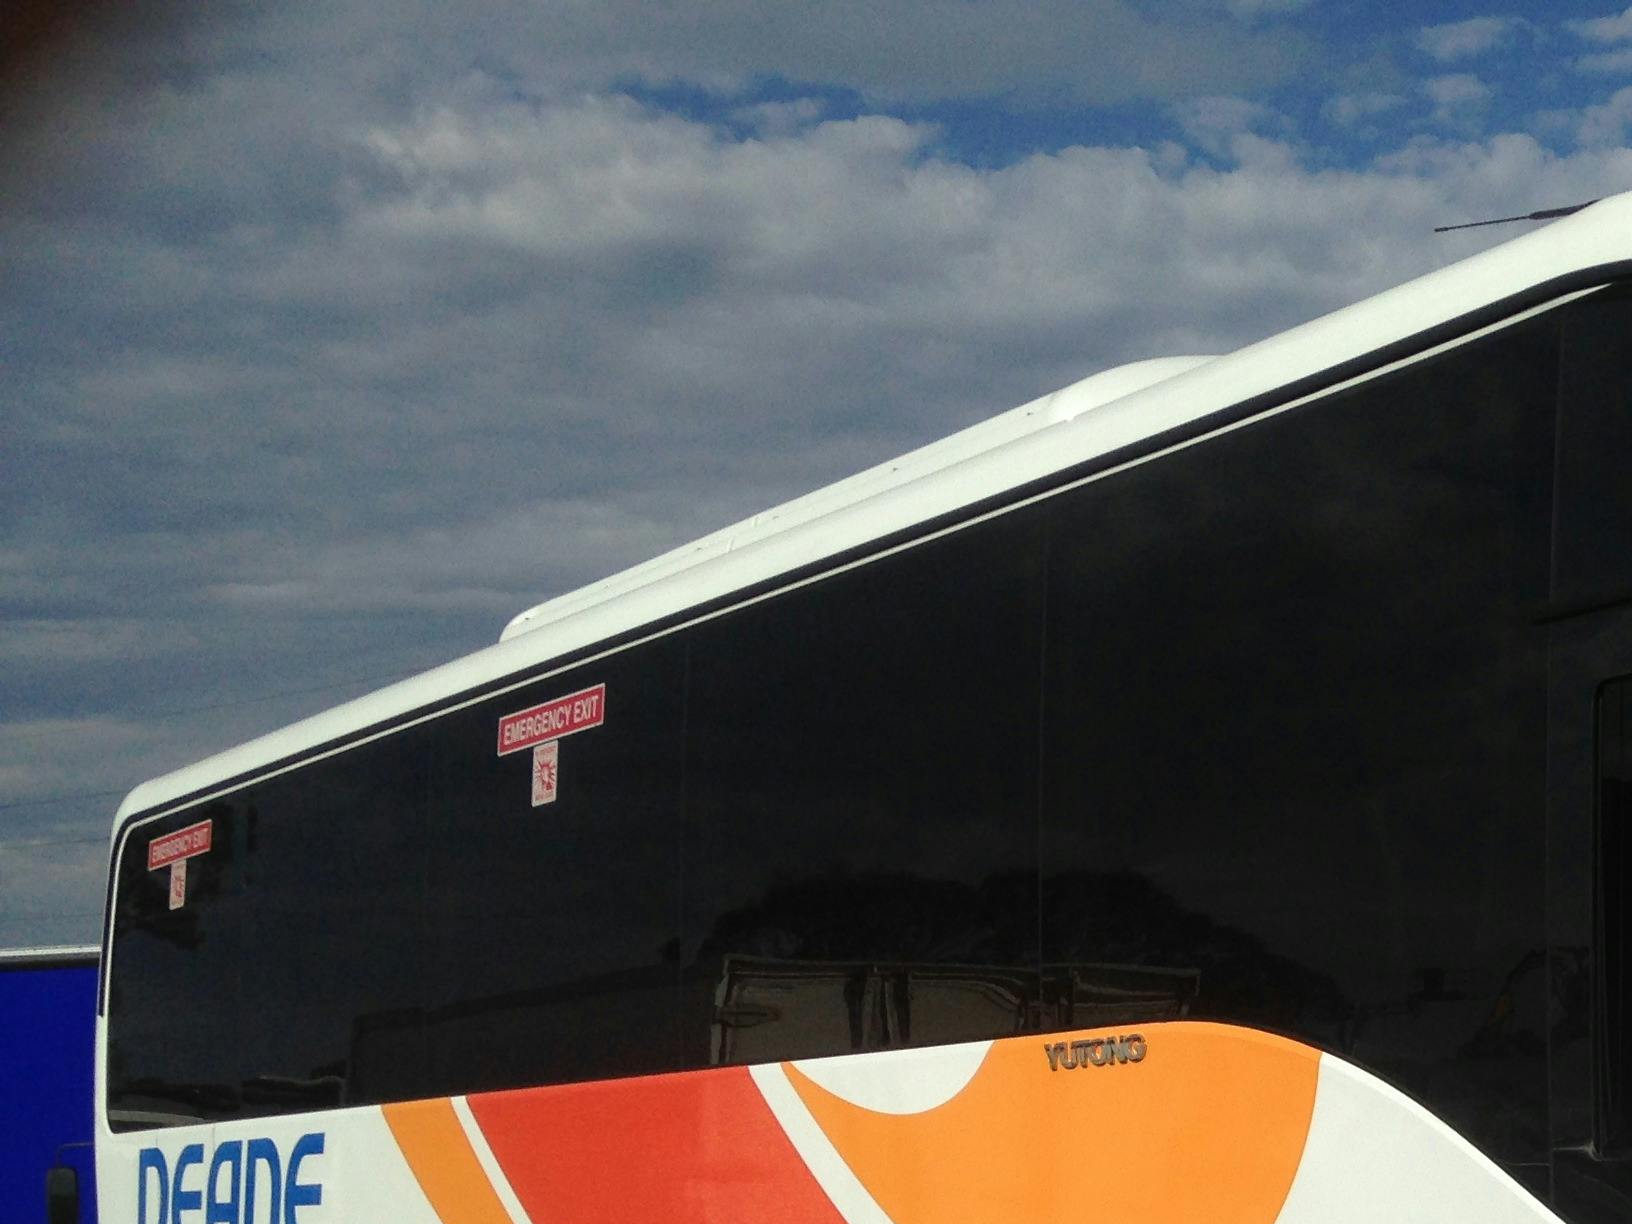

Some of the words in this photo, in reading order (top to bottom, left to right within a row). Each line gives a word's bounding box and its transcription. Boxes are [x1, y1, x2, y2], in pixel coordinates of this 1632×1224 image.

[504, 705, 572, 745] EMERGENCY
[573, 695, 599, 723] EXIT
[1044, 1034, 1147, 1072] YUTONG
